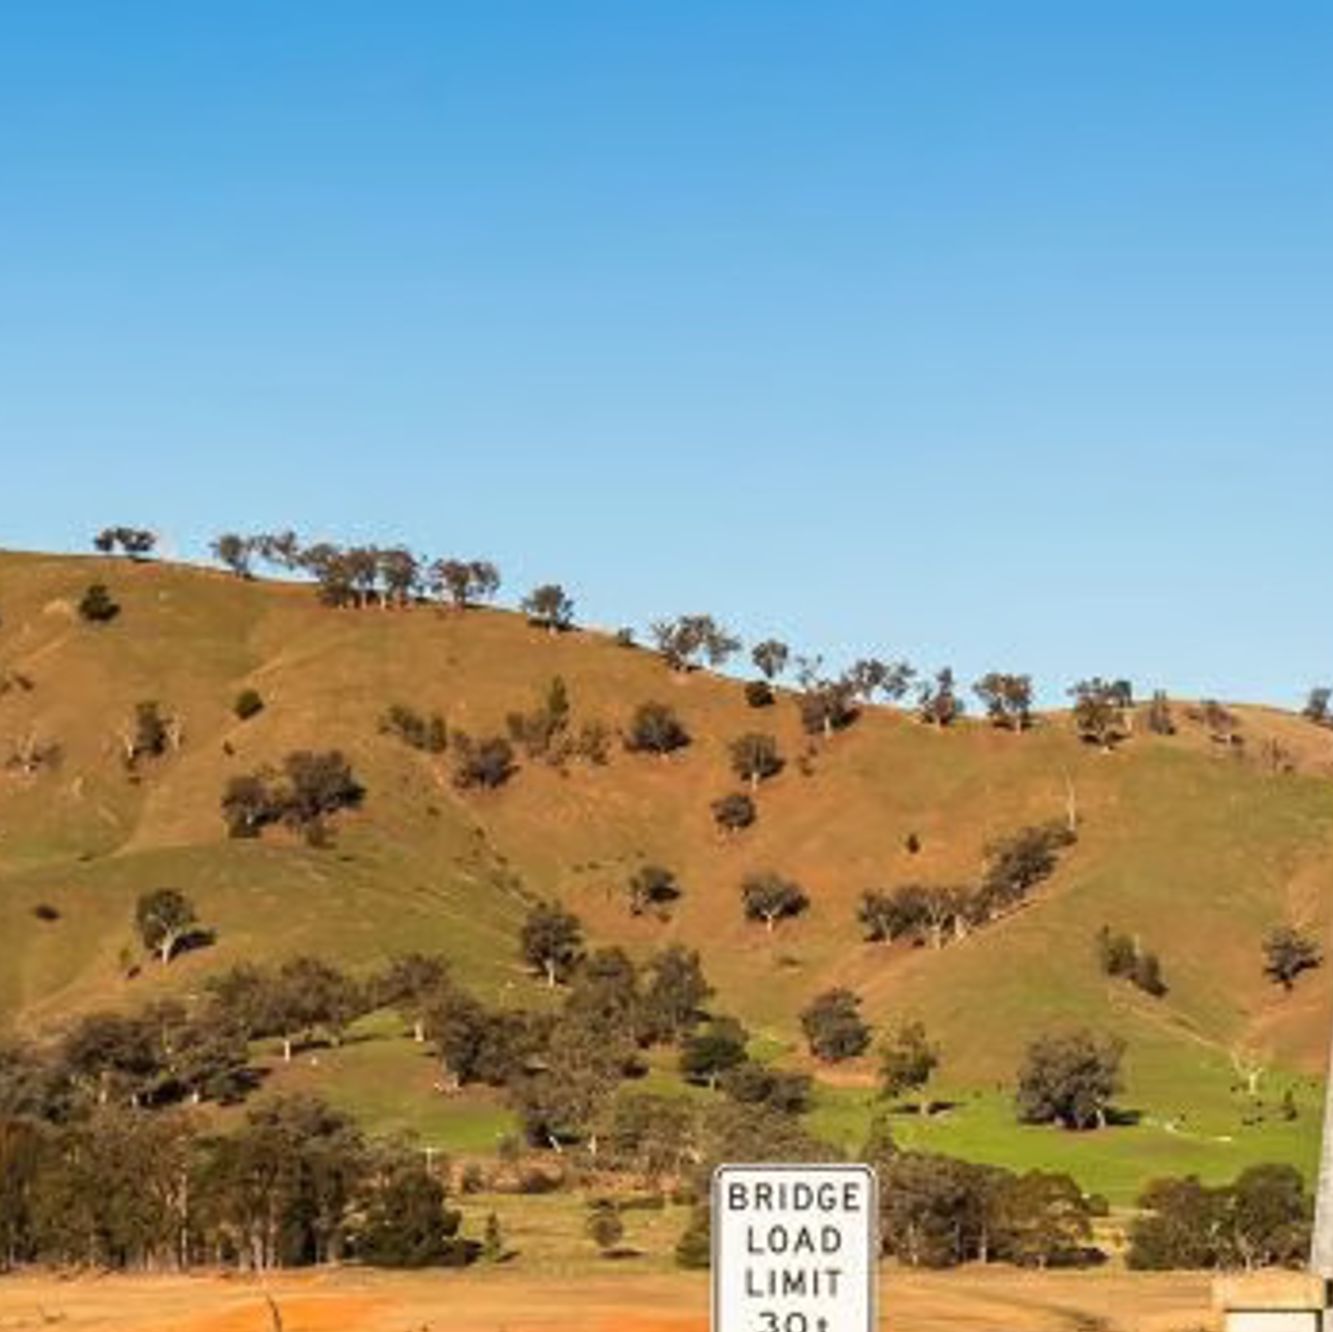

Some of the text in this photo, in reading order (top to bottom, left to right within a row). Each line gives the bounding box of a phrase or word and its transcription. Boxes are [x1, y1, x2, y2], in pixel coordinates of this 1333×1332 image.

[727, 1182, 861, 1212] BRIDGE
[746, 1224, 842, 1254] LOAD
[745, 1268, 843, 1298] LIMIT
